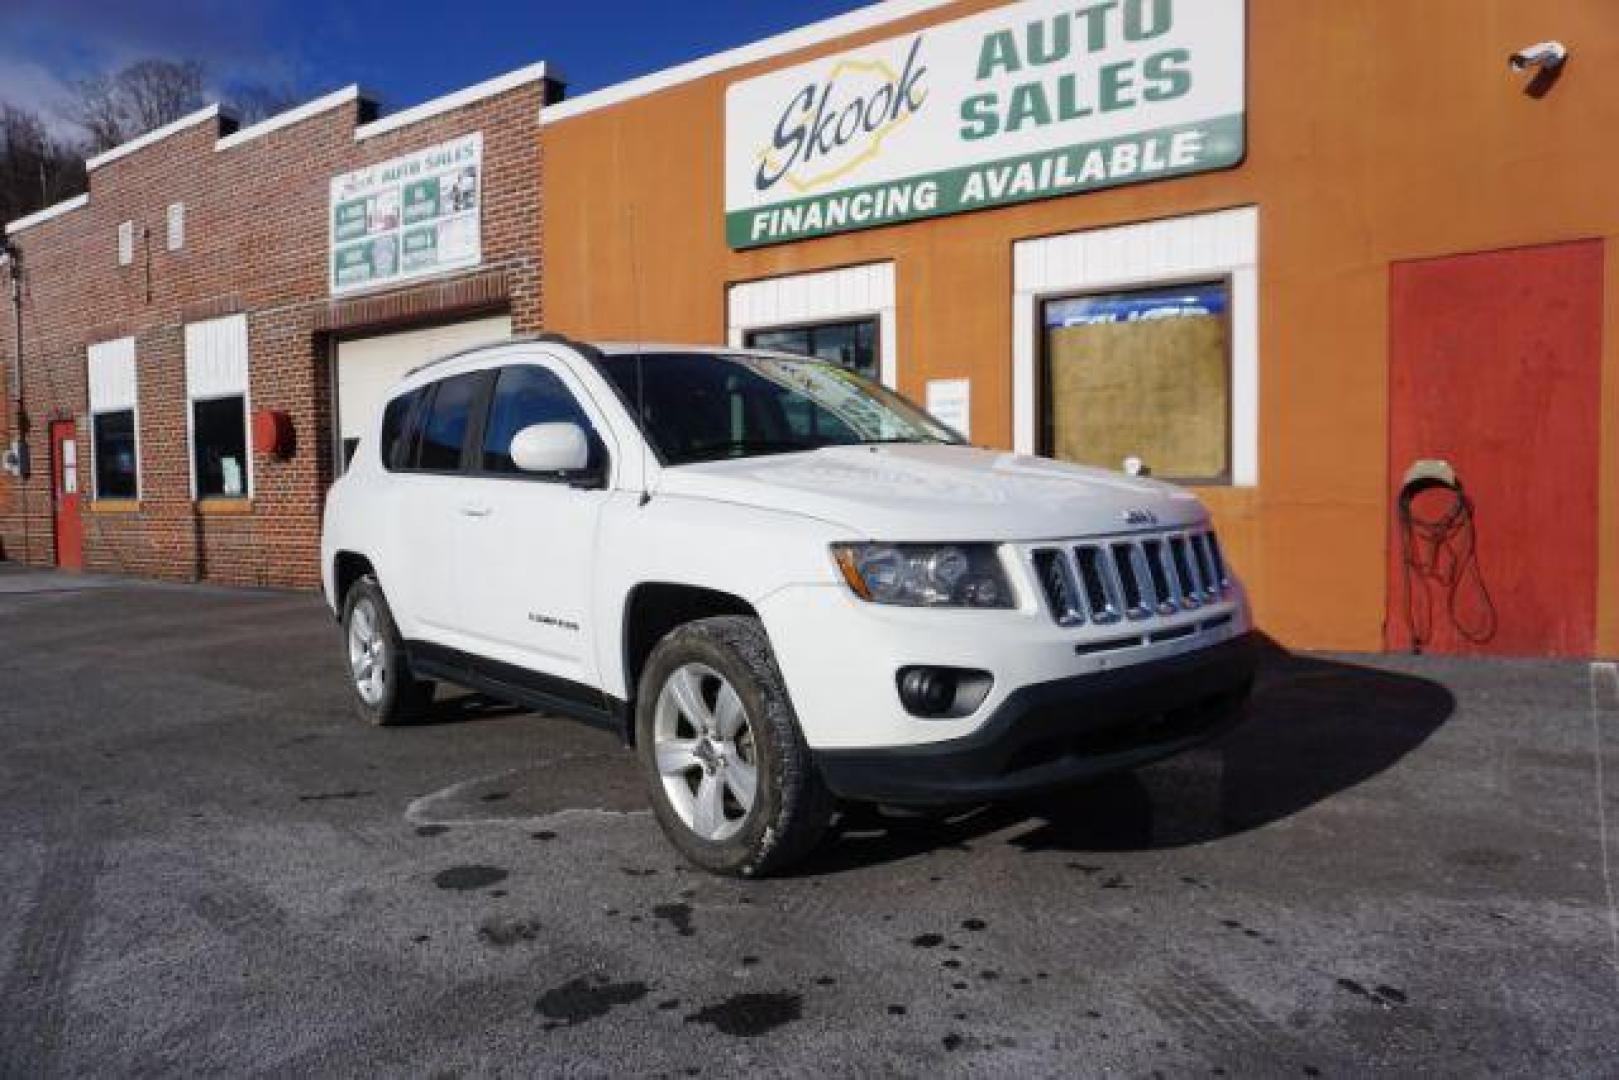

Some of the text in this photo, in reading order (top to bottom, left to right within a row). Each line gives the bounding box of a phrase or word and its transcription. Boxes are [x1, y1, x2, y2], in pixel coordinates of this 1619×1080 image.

[977, 0, 1173, 79] AUTO
[757, 37, 928, 190] Skook
[960, 49, 1192, 141] SALES
[751, 132, 1202, 240] FINANCING AVAILABLE
